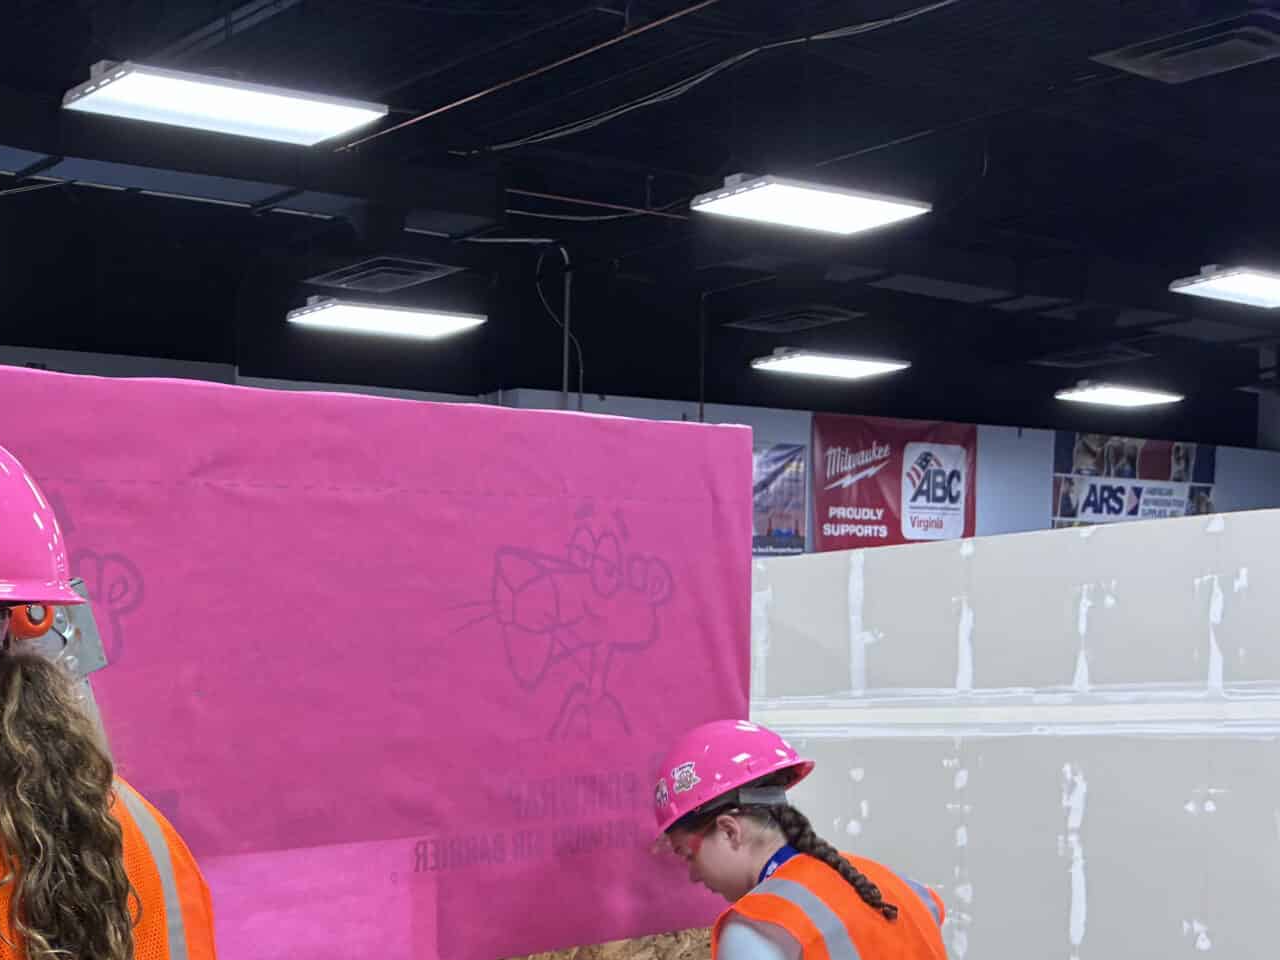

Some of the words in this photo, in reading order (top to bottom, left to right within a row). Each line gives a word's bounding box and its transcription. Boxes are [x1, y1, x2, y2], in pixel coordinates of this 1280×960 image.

[825, 440, 891, 480] Milwaukee
[910, 468, 961, 505] ABC
[1082, 484, 1126, 515] ARS
[828, 506, 884, 521] PROUDLY
[909, 515, 944, 532] Virginia
[823, 523, 888, 538] SUPPORTS
